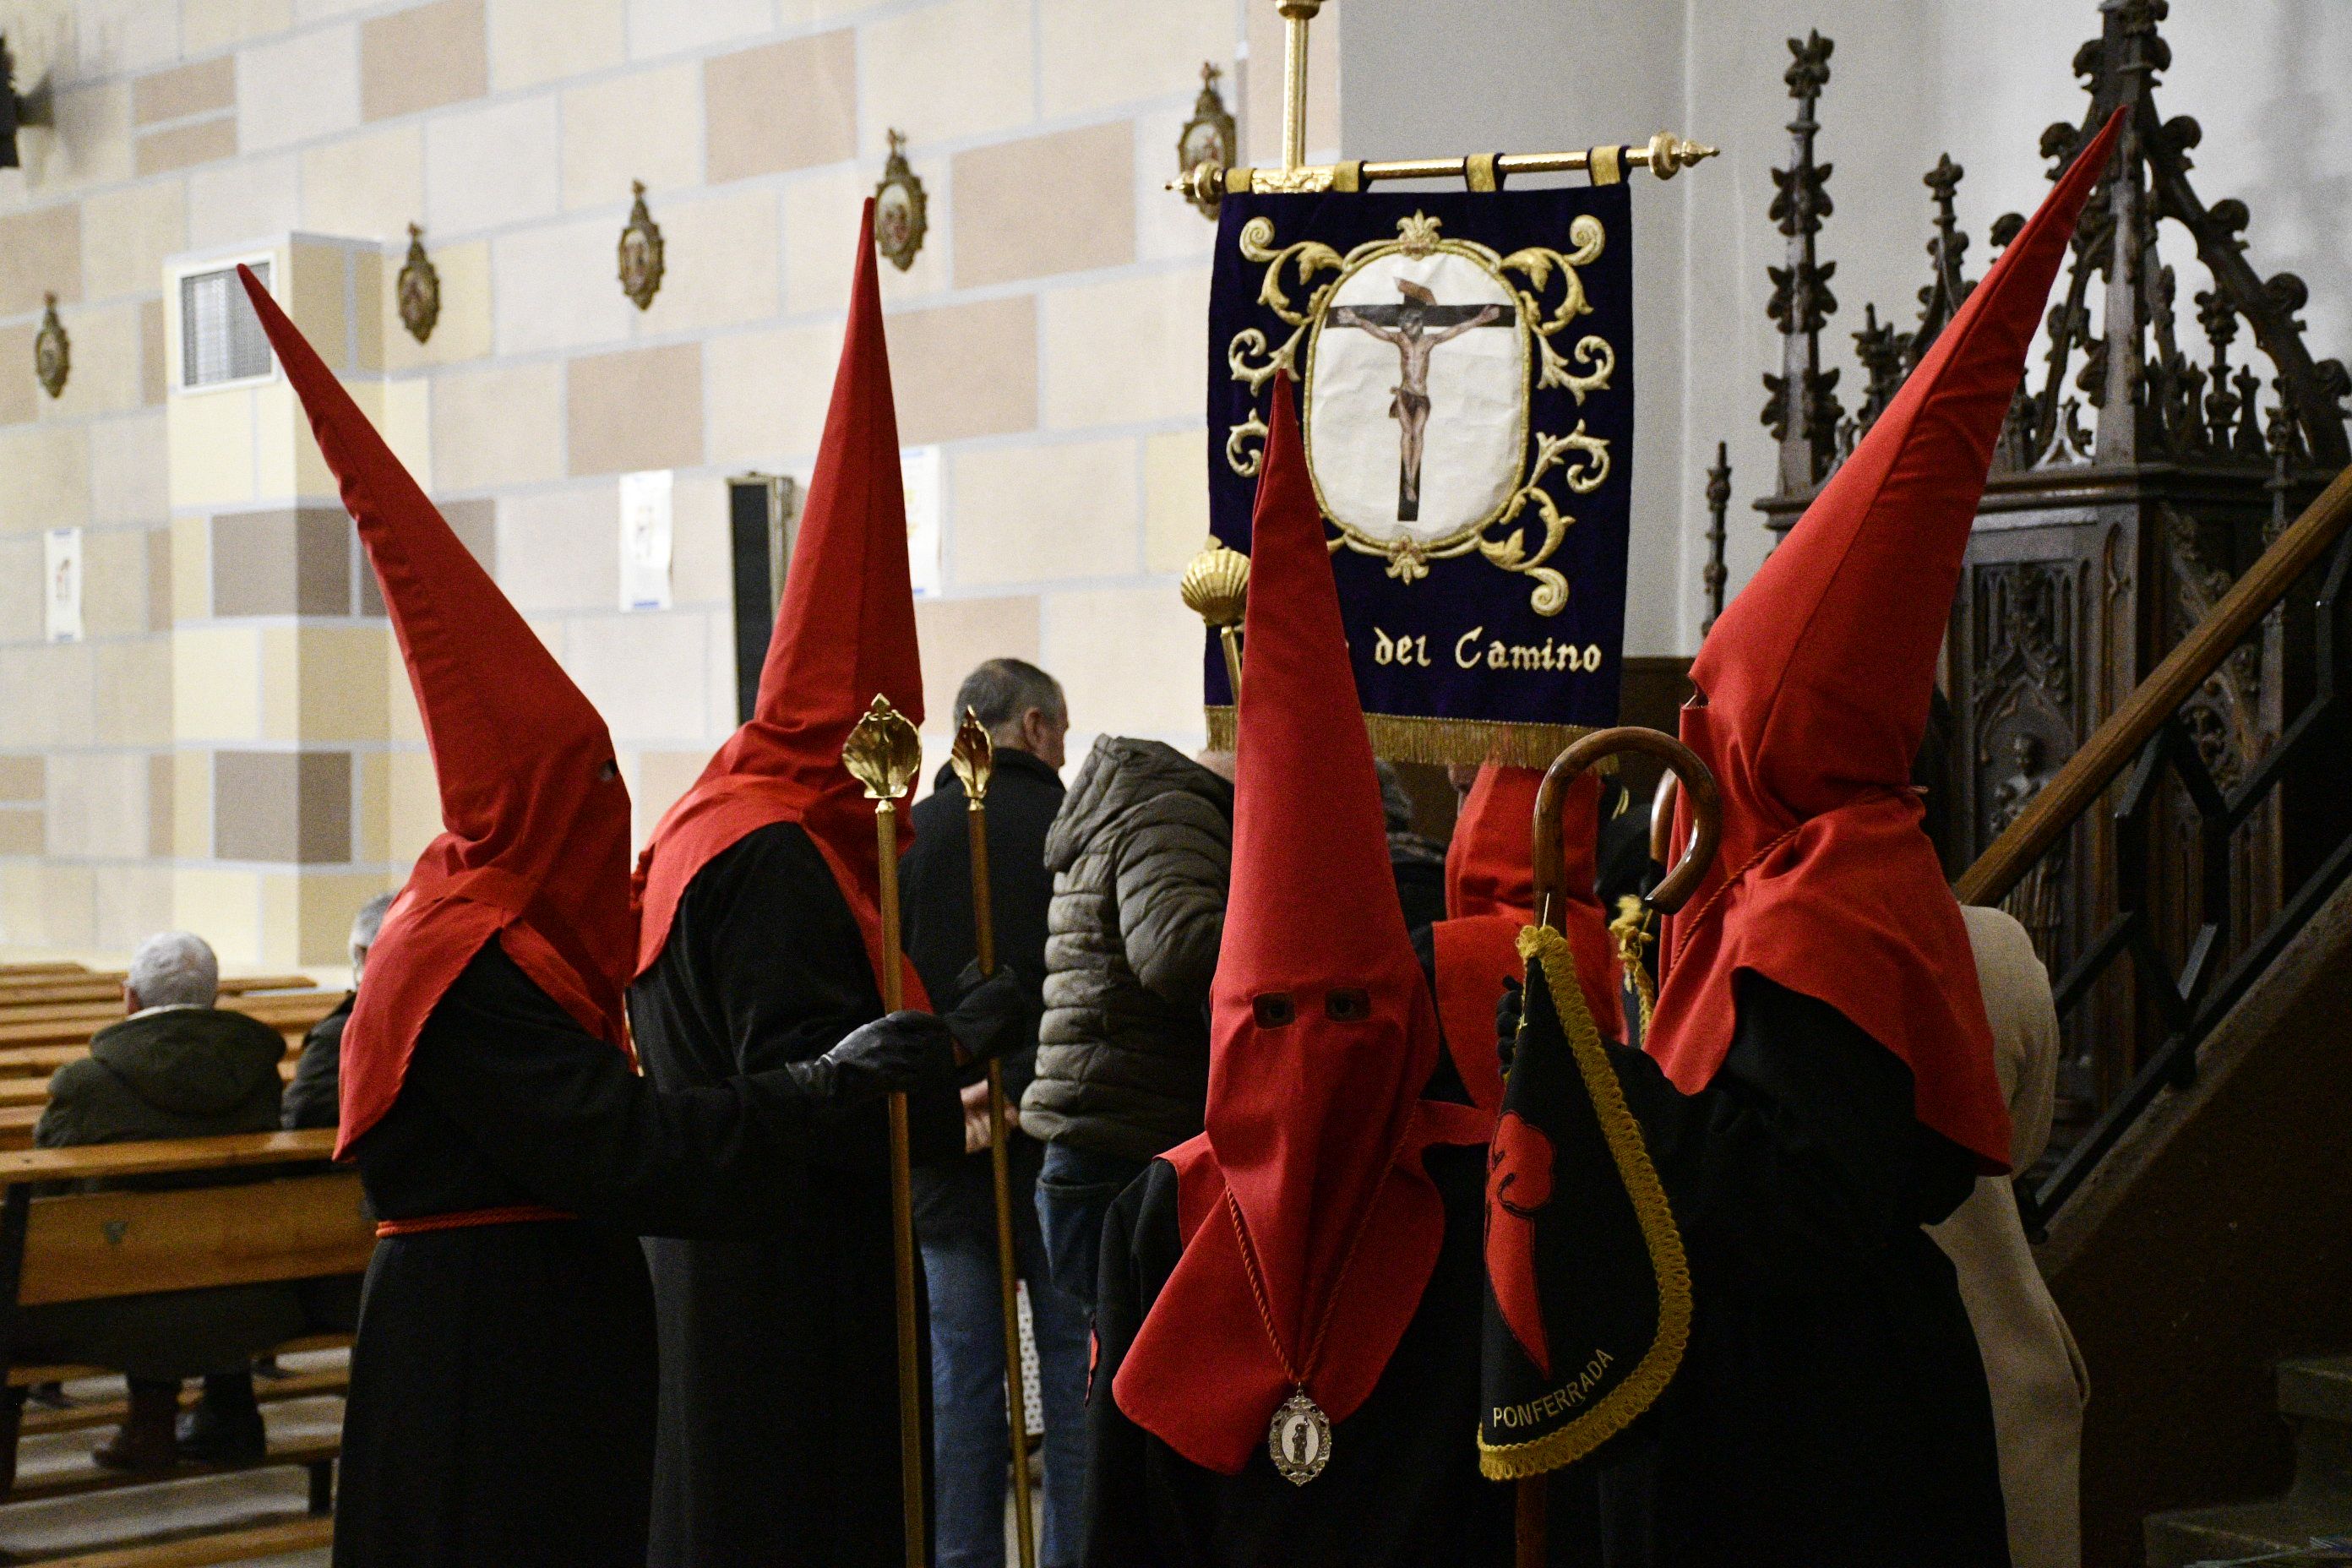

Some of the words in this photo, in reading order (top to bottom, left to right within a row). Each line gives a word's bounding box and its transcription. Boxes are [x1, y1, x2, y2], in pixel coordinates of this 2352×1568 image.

[1374, 626, 1431, 666] del
[1455, 626, 1602, 672] Camino
[1493, 1348, 1614, 1429] PONFERRADA
